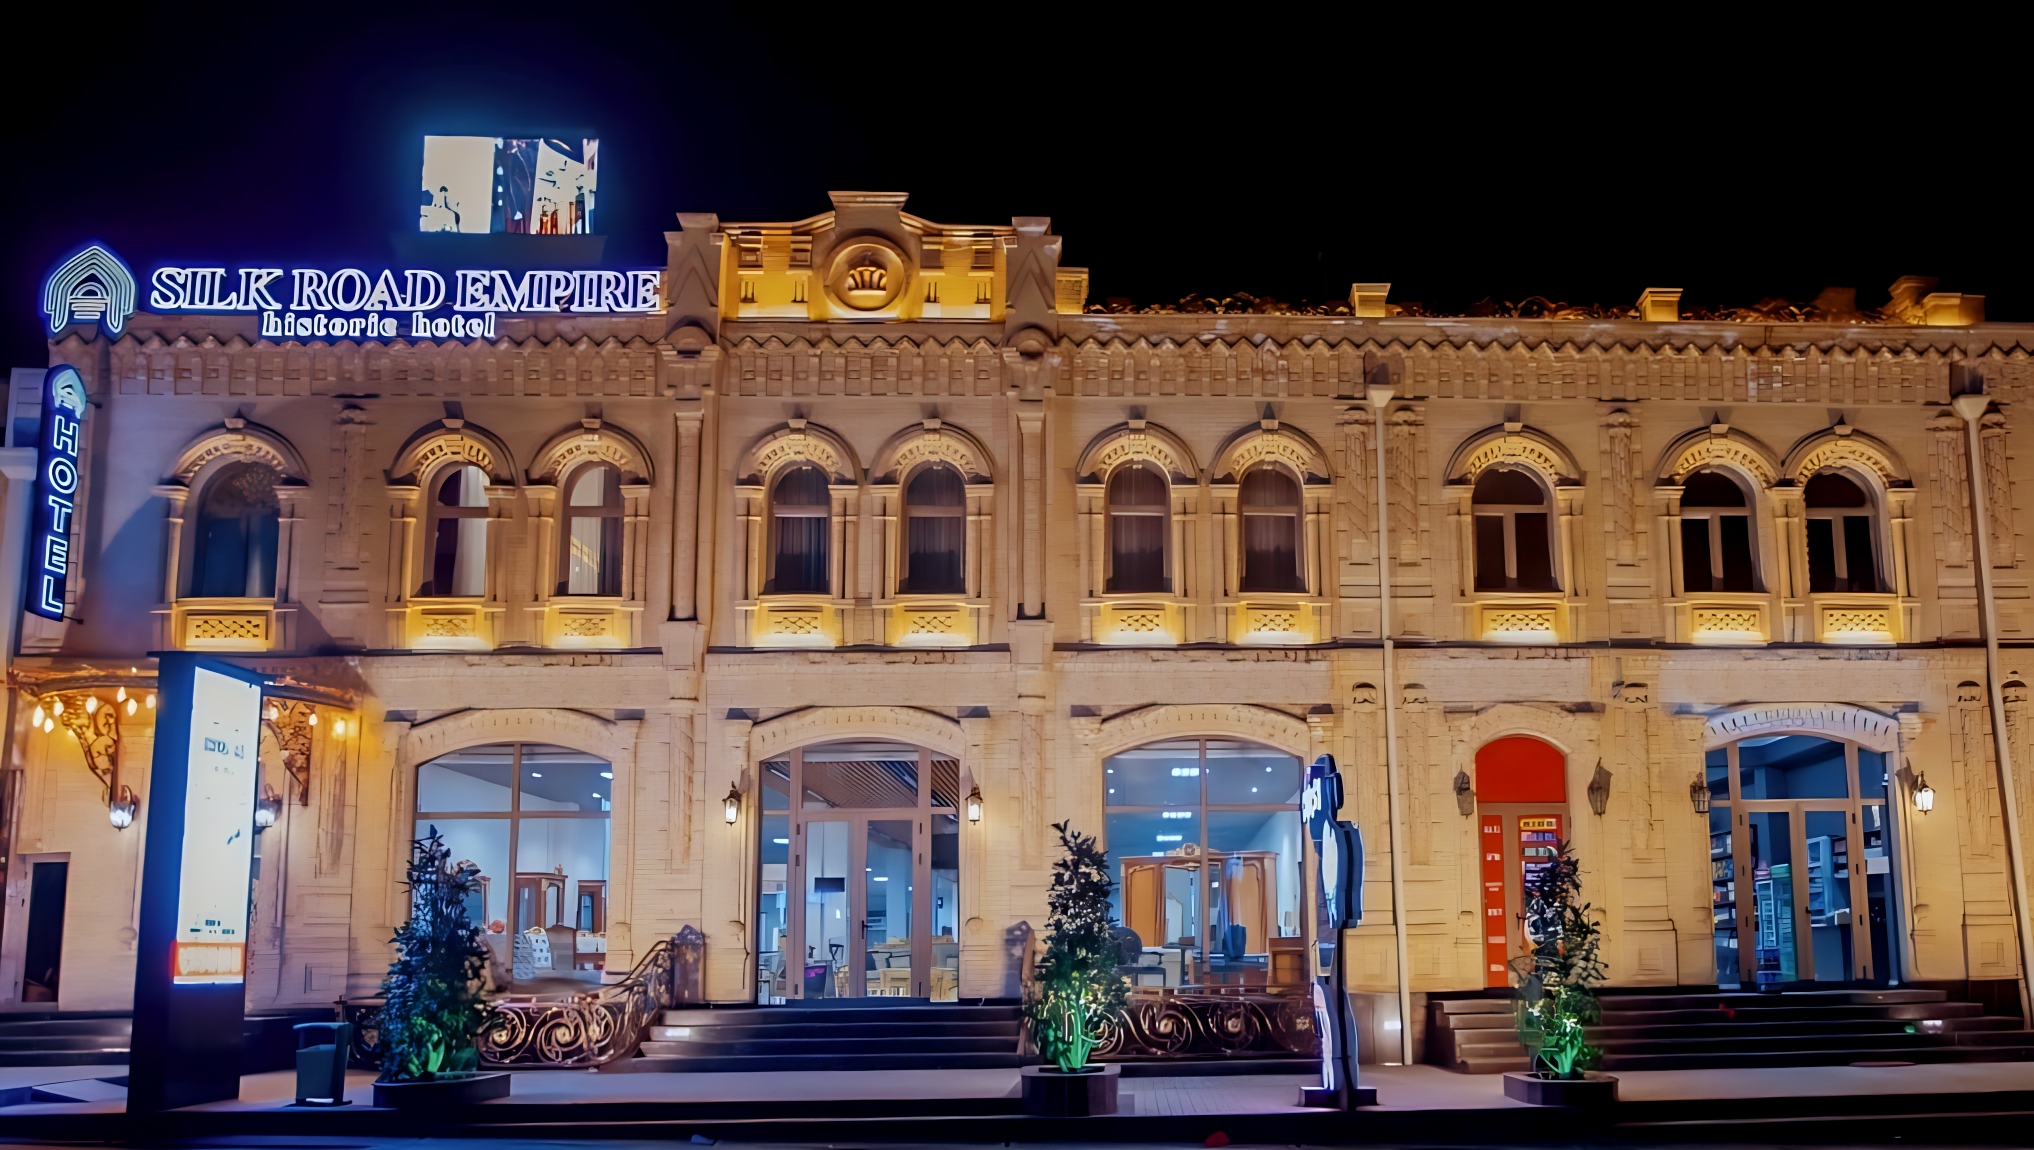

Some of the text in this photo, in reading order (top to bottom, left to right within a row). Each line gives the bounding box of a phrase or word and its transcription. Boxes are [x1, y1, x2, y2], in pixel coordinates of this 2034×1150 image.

[150, 267, 661, 313] SILK ROAD EMPIRE
[262, 310, 496, 338] historic hotel
[41, 415, 79, 613] HOTEL
